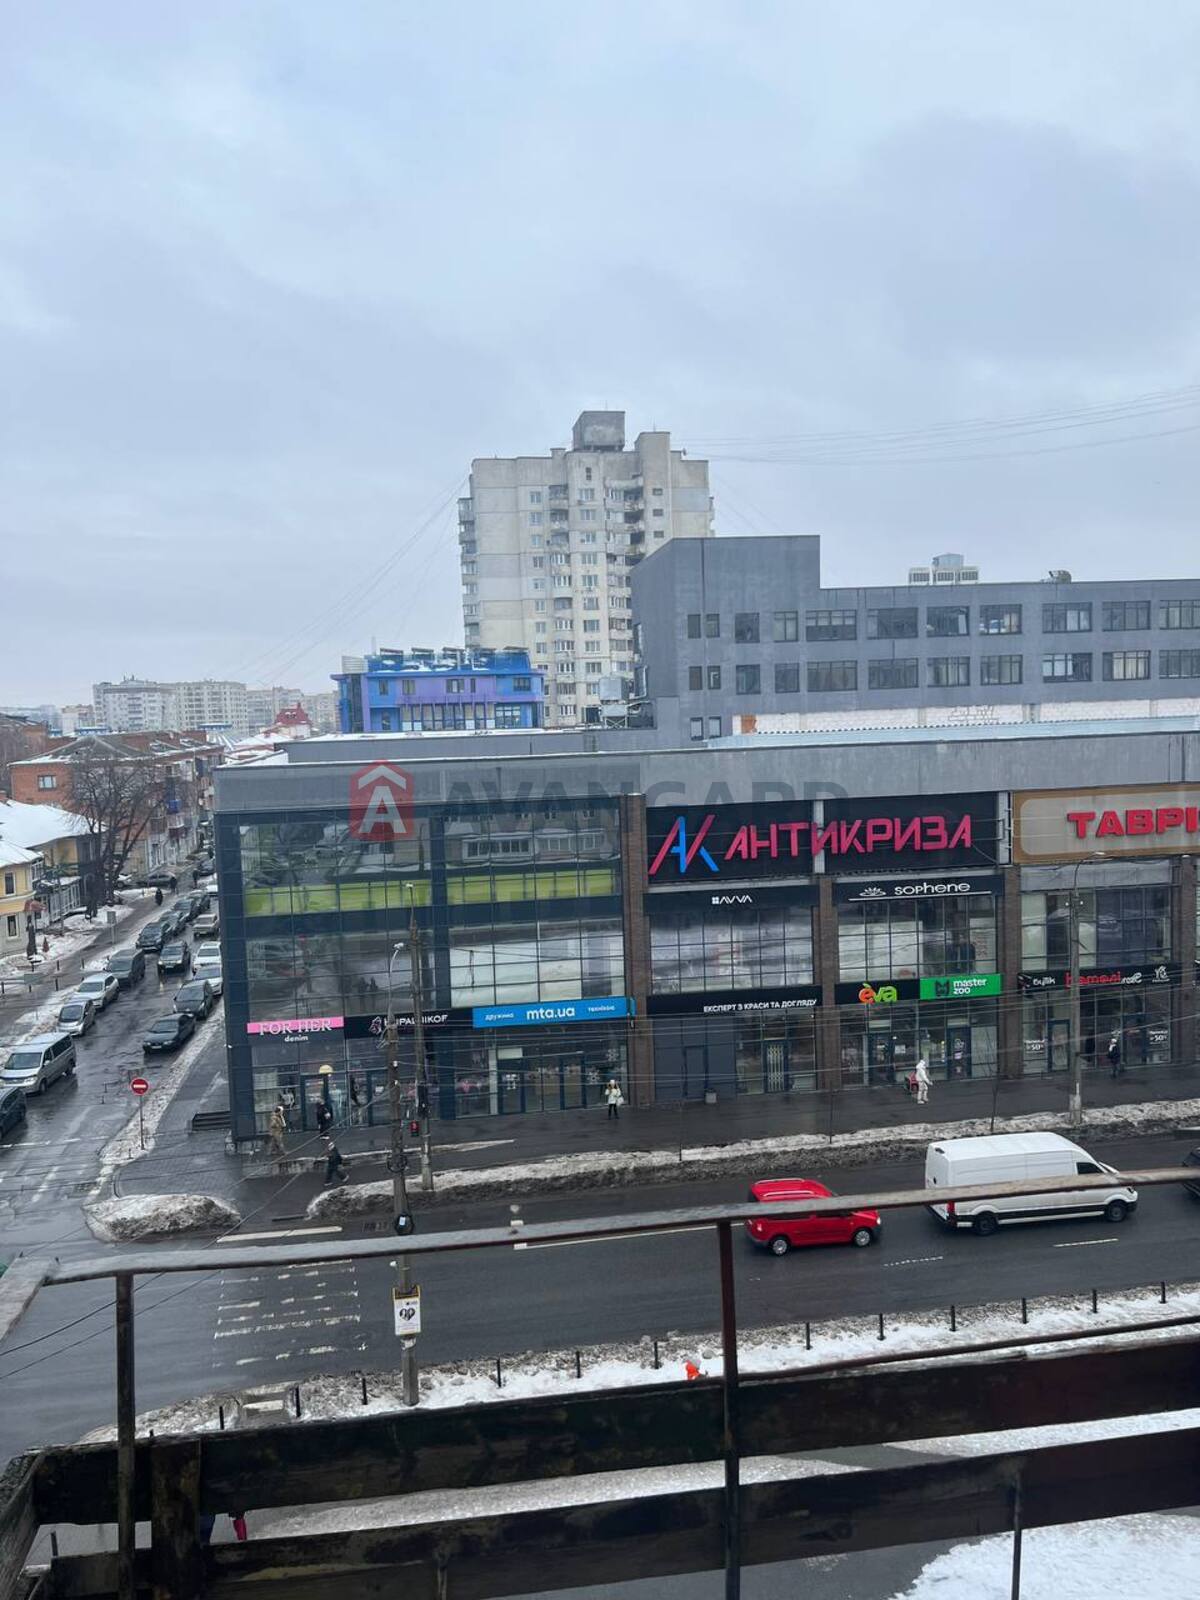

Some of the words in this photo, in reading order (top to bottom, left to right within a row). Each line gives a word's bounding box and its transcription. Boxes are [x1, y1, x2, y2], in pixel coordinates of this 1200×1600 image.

[725, 815, 971, 860] АНТИКРИЗА
[953, 978, 987, 988] master
[953, 987, 971, 995] zoo
[526, 1006, 576, 1020] mta.ua
[704, 1004, 737, 1013] ЕКСПЕРТ
[744, 1002, 769, 1010] КРАСИ
[770, 1001, 780, 1009] ТА
[781, 999, 817, 1008] ДОГЛЯДУ
[259, 1023, 293, 1035] FOR
[299, 1018, 332, 1033] HER
